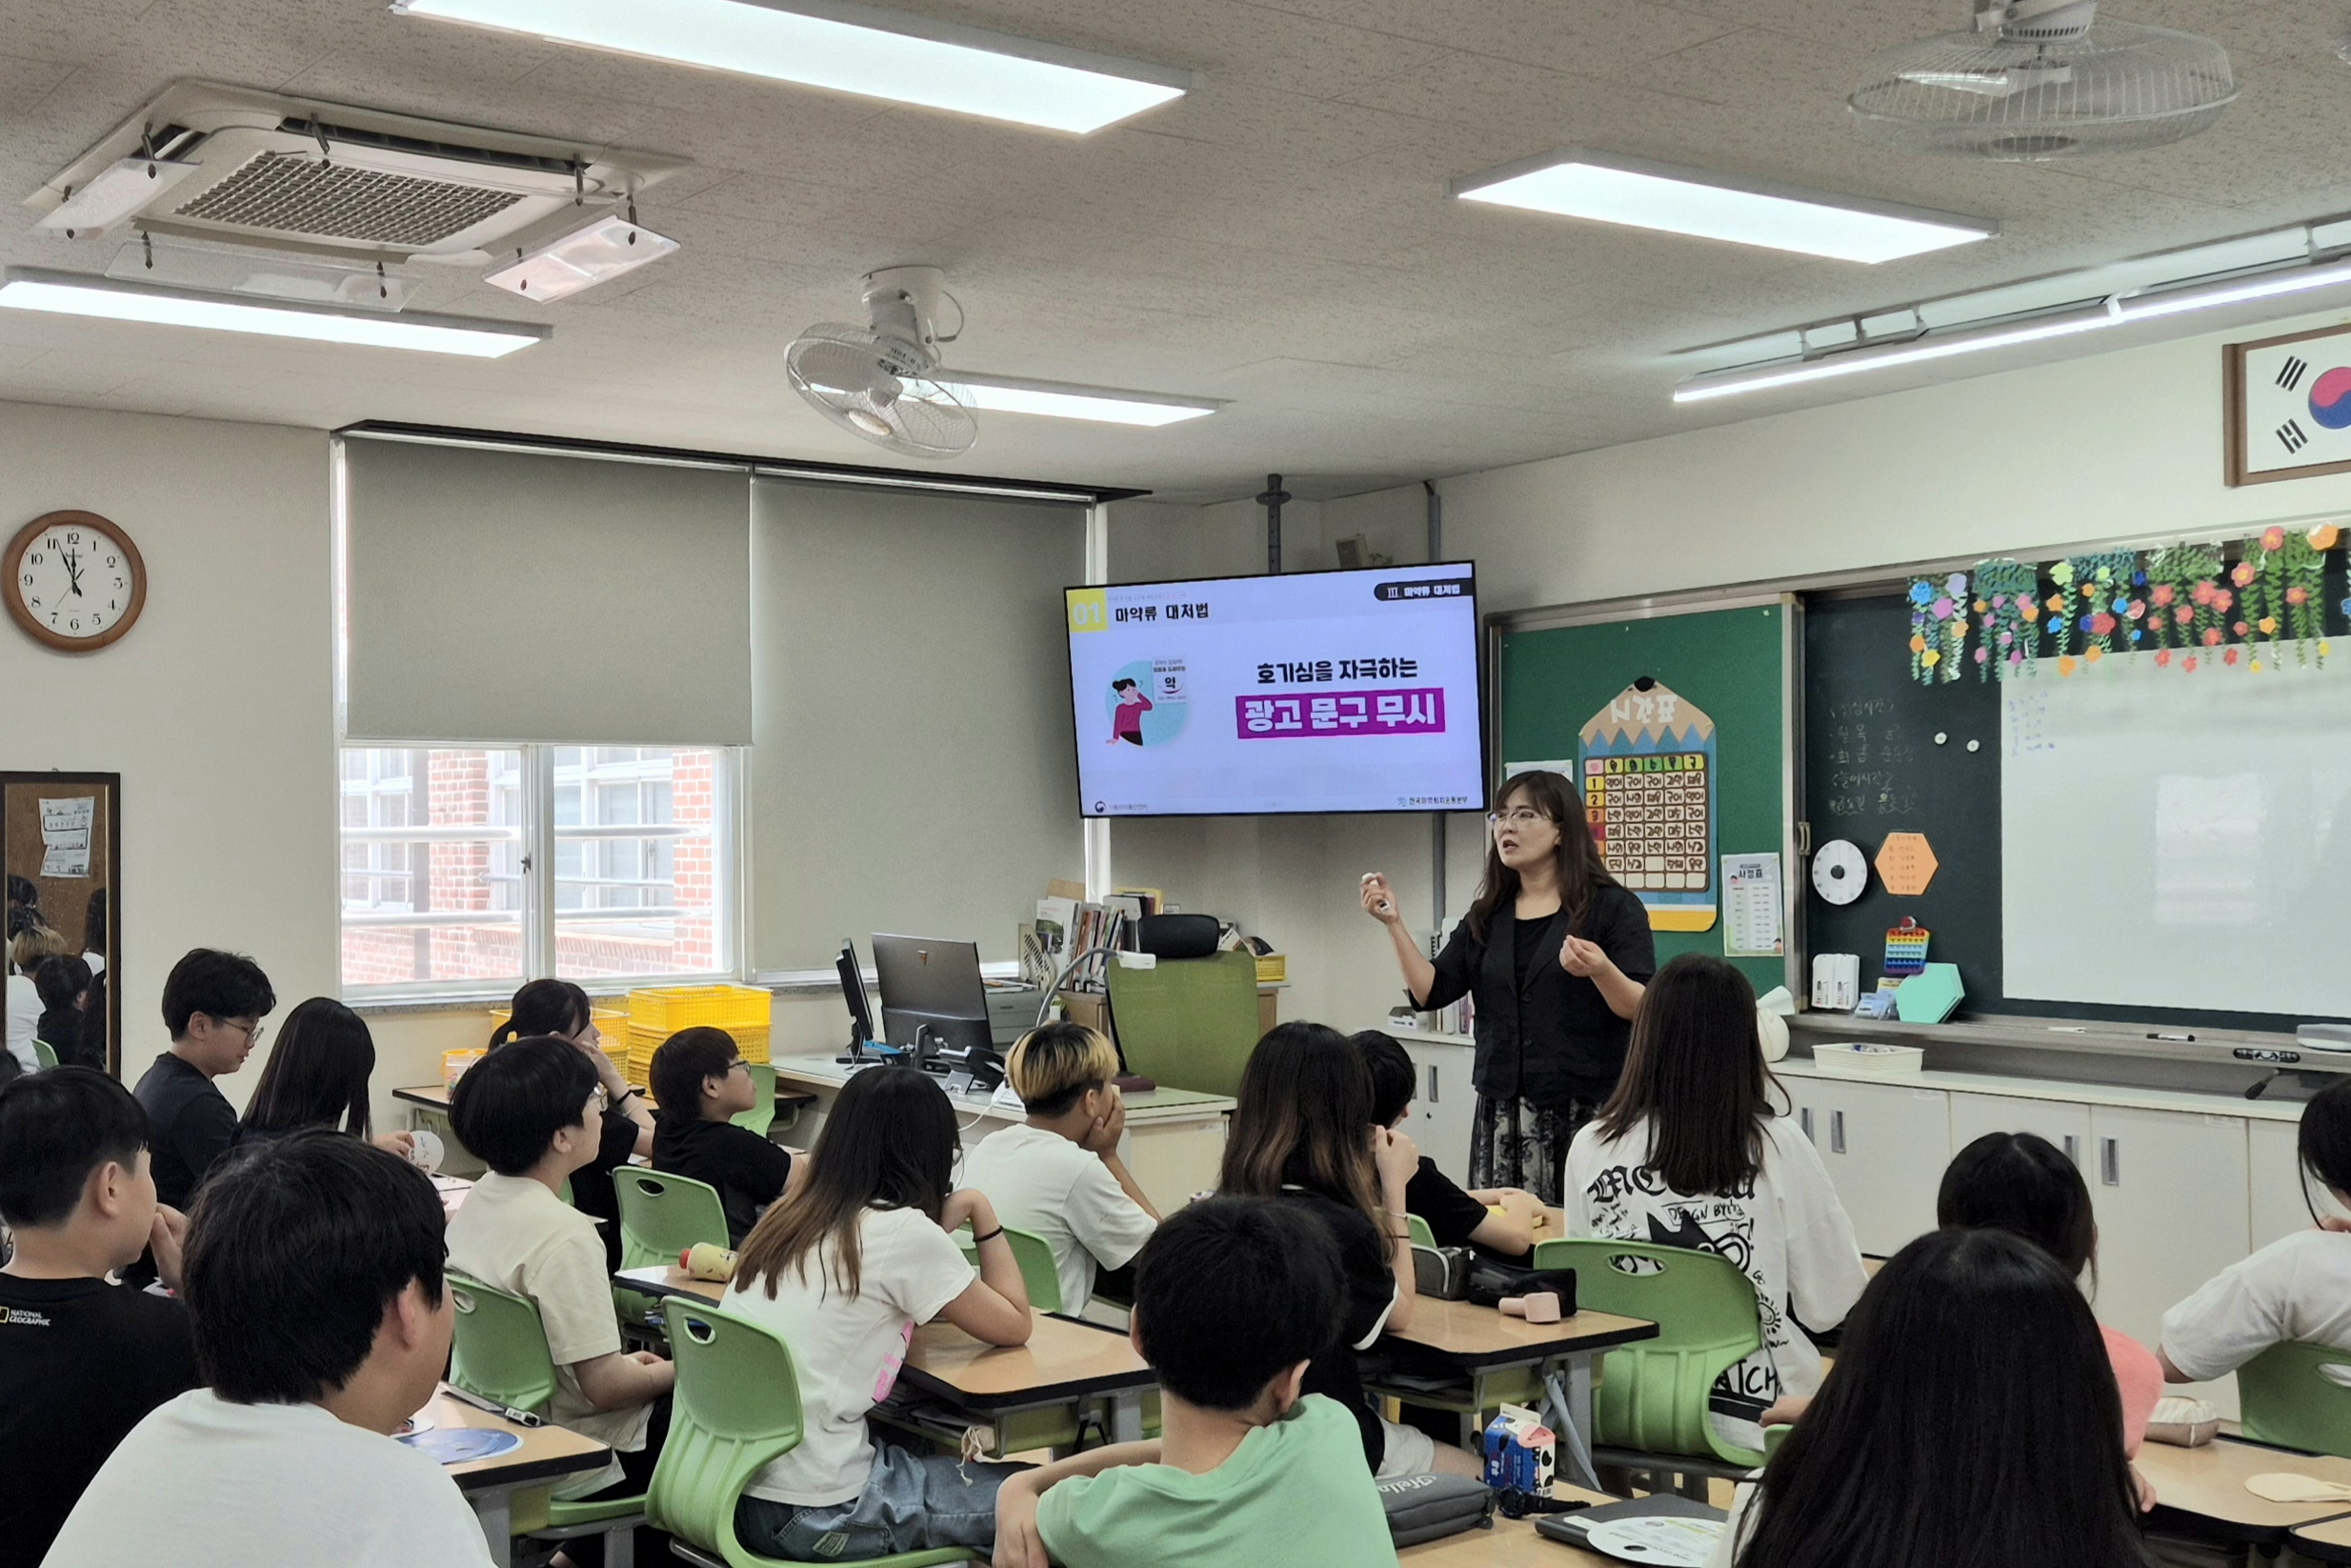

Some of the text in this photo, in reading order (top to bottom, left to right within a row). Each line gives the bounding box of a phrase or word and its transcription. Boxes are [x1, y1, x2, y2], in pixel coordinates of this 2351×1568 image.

[68, 533, 79, 544] 12
[31, 553, 43, 565] 10
[107, 556, 115, 568] 2
[24, 574, 33, 586] 9
[114, 577, 123, 589] 3
[1404, 586, 1430, 597] 마약류
[1434, 584, 1460, 595] 대처법
[31, 597, 41, 608] 8
[108, 599, 115, 610] 4
[50, 613, 58, 624] 7
[1074, 602, 1101, 626] 01
[1115, 603, 1209, 622] 마약류 대처법
[70, 618, 79, 630] 6
[92, 613, 101, 625] 5
[1257, 657, 1417, 684] 호기심을 자극하는
[1165, 676, 1176, 689] 약
[1245, 694, 1436, 732] 광고 문구 무시
[1611, 694, 1677, 723] 시간표
[1591, 794, 1597, 805] 2
[1591, 811, 1598, 821] 3
[1738, 870, 1763, 879] 시정표
[10, 1309, 43, 1319] NATIONAL
[9, 1317, 51, 1326] GEOGRAPHIC
